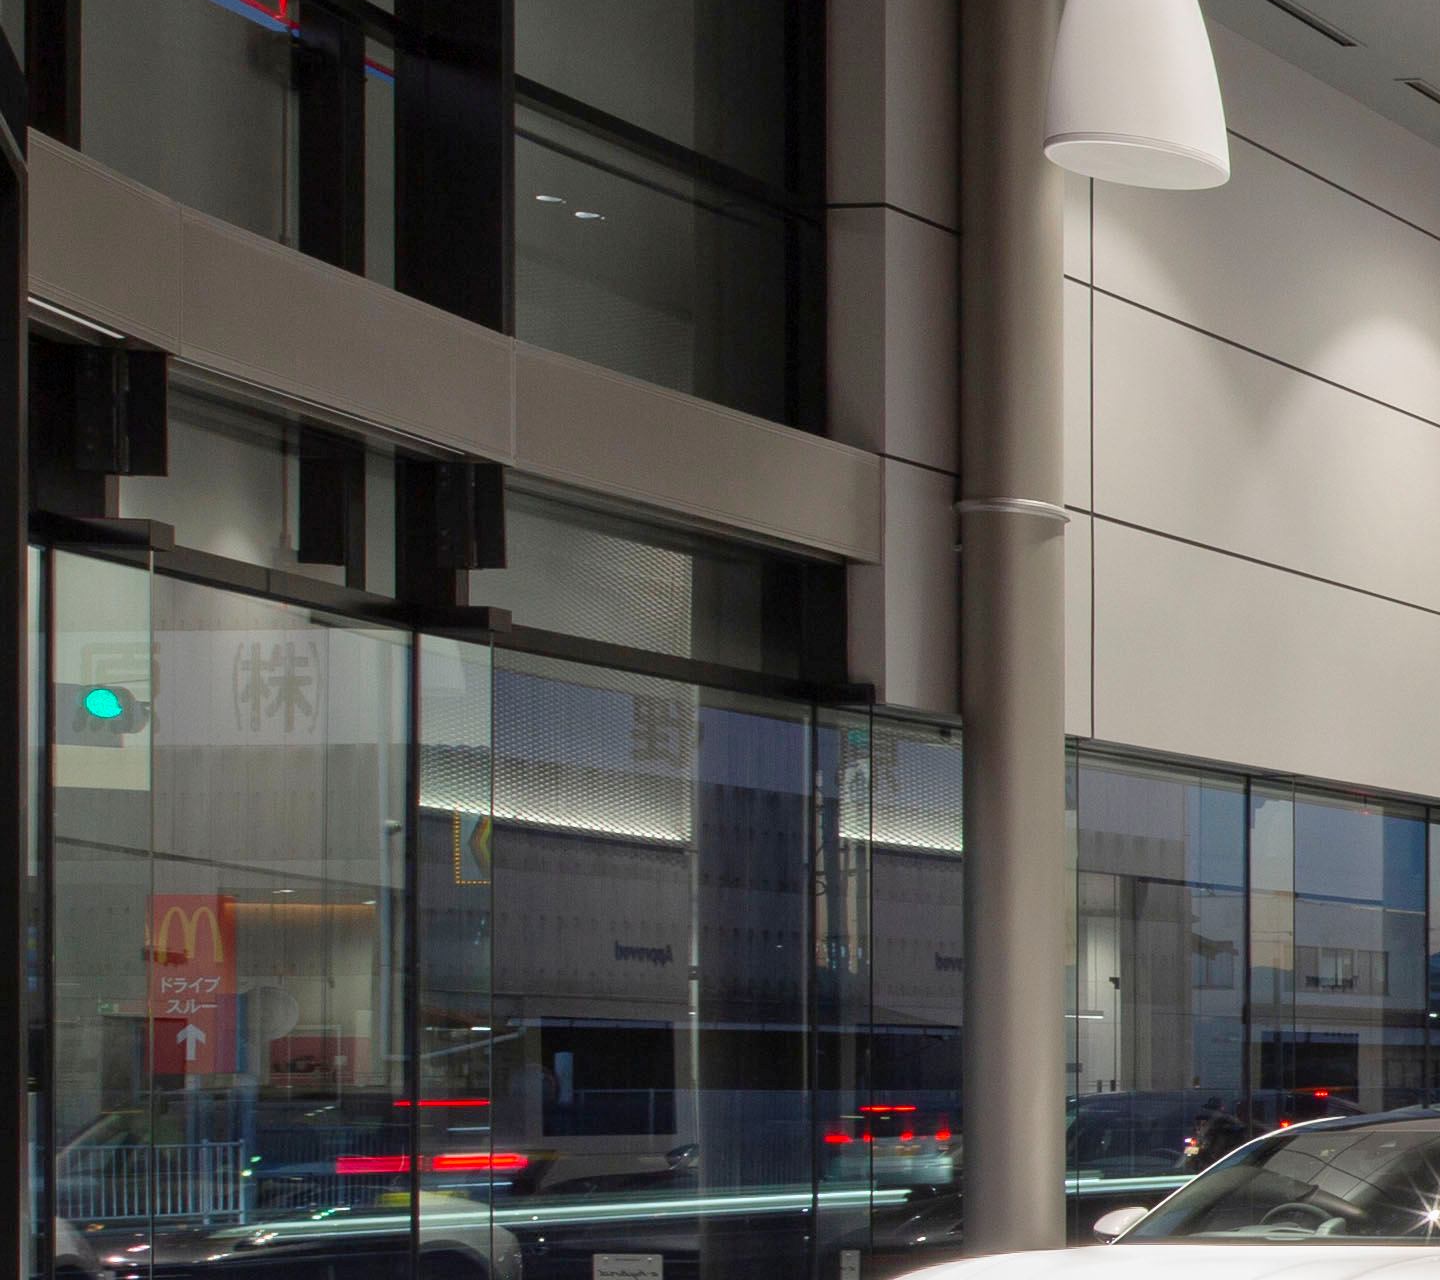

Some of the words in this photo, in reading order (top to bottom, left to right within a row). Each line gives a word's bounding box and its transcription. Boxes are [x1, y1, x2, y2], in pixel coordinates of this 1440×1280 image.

[161, 976, 221, 993] ドライブ
[165, 999, 219, 1014] スルー
